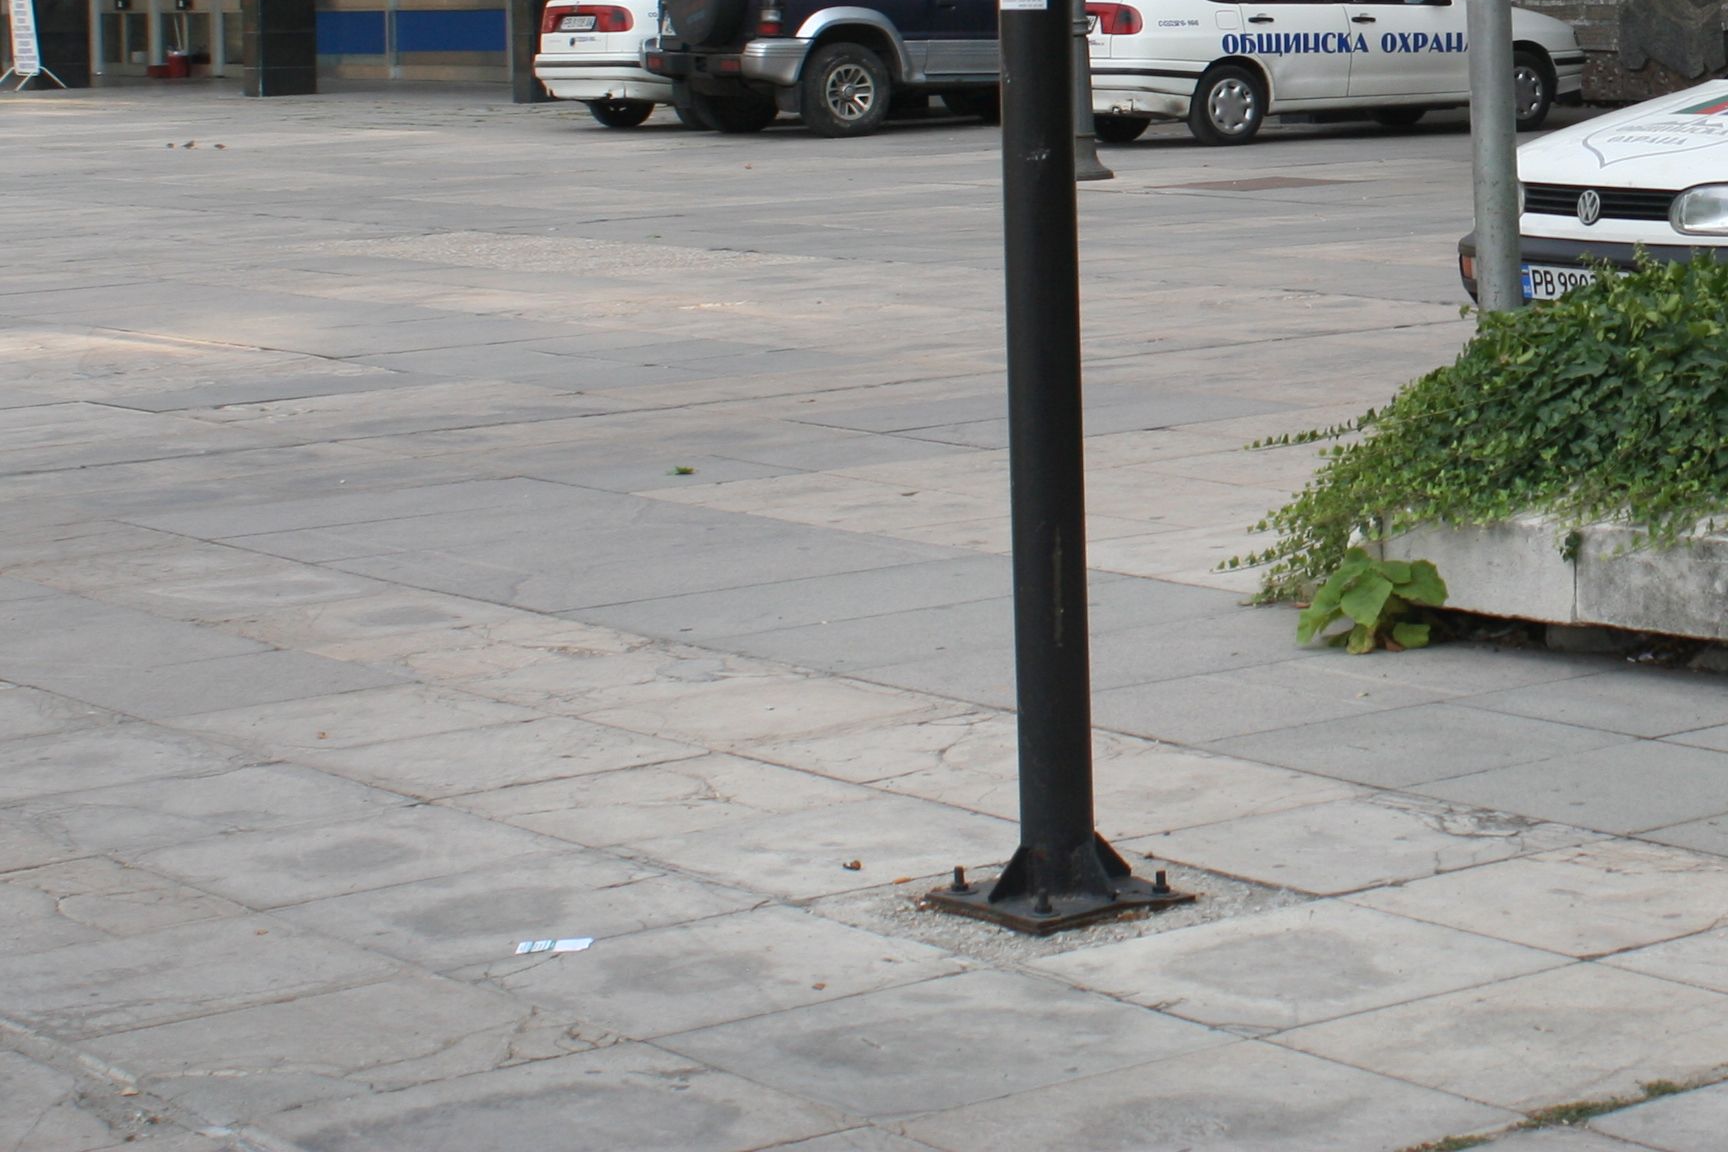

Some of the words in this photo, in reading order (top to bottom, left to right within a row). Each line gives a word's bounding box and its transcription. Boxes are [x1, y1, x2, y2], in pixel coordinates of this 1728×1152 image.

[1222, 32, 1369, 57] ОБЩИНСКА
[1380, 32, 1468, 54] ОХРАН
[1531, 269, 1556, 296] PB
